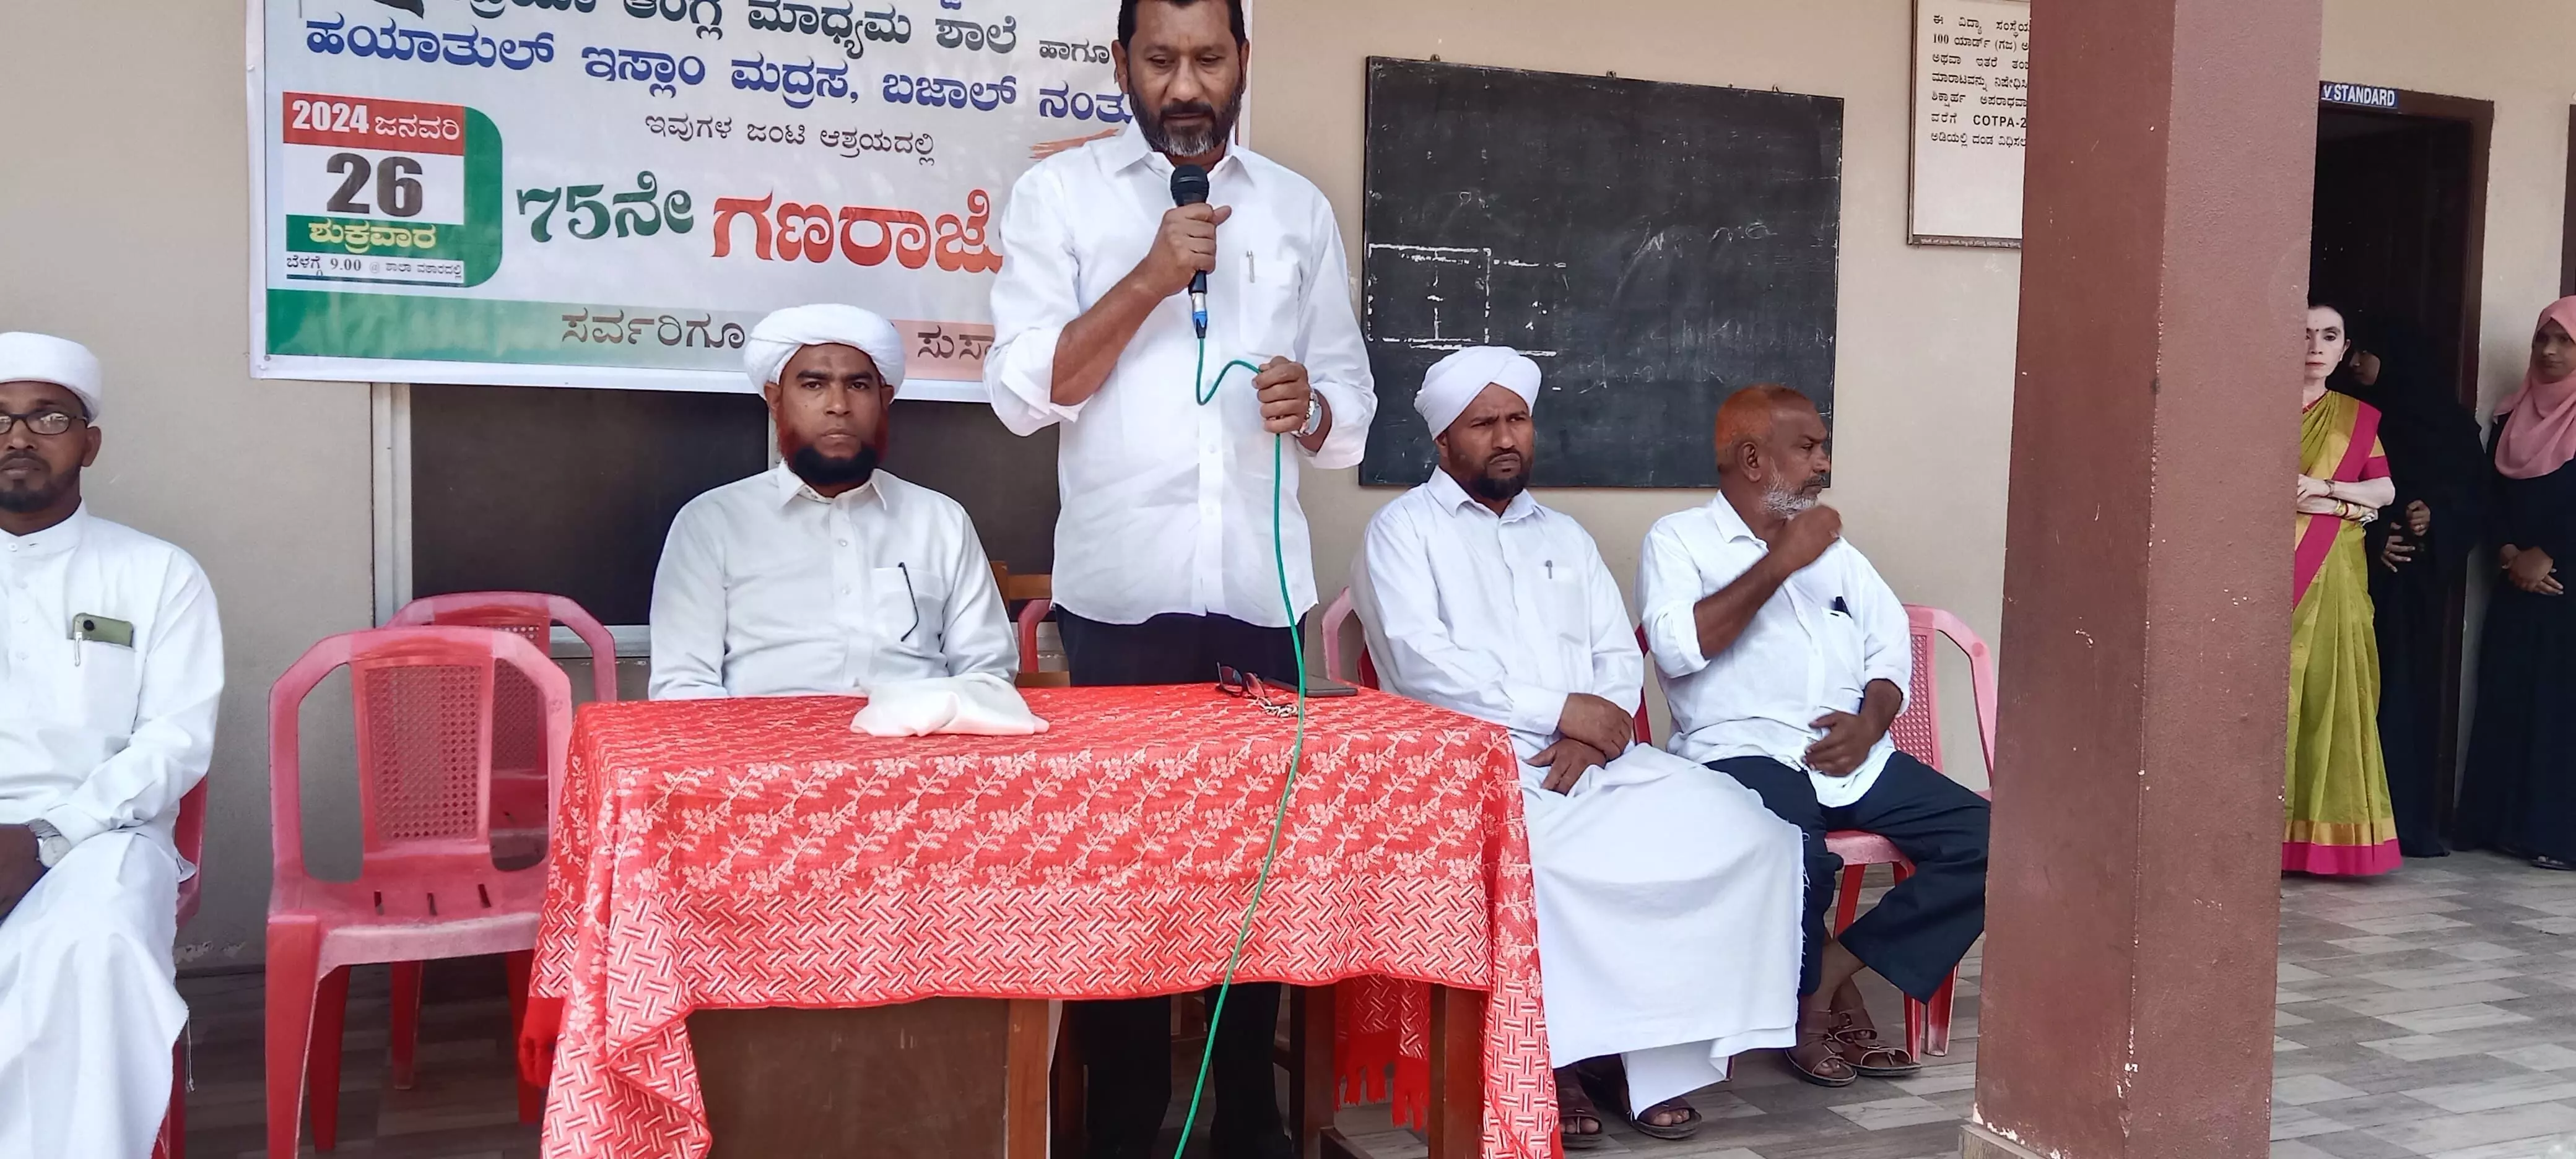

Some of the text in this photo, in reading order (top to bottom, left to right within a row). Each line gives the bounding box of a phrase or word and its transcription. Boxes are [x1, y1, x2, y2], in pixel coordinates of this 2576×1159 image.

[747, 0, 912, 60] ಮಾಧ್ಯಮ
[935, 14, 1017, 54] ಶಾಲೆ
[1039, 38, 1110, 64] ಹಾಗೂ
[1958, 16, 1982, 35] ವಿದ್ಯಾ
[1933, 33, 1949, 45] 100
[1995, 38, 2017, 53] (ಗಜ)
[307, 11, 554, 71] ಹಯಾತುಲ್
[581, 46, 706, 98] ಇಸ್ಲಾಂ
[731, 50, 859, 109] ಮದ್ರಸ,
[882, 73, 1017, 112] ಬಜಾಲ್
[1932, 53, 1962, 65] ಅಥವಾ
[1975, 56, 1998, 68] ಇತರೆ
[1931, 72, 1988, 92] ಮಾರಾಟವನ್ನು
[1931, 90, 1967, 108] ಶಿಕ್ಷಾರ್ಹ
[2333, 84, 2395, 106] STANDARD
[292, 99, 460, 141] 2024 ಜನವರಿ
[1931, 111, 1957, 124] ವರೆಗೆ
[645, 113, 935, 166] ಇವುಗಳ ಜಂಟಿ ಆಶ್ರಯದಲ್ಲಿ
[1931, 131, 1968, 149] ಅಡಿಯಲ್ಲಿ
[1972, 134, 1994, 145] ದಂಡ
[326, 152, 423, 217] 26
[516, 170, 695, 243] 75ನೇ
[308, 218, 437, 254] ಶುಕ್ರವಾರ
[286, 254, 323, 277] ಬೆಳಗ್ಗೆ
[330, 258, 362, 271] 9.00
[562, 307, 745, 349] ಸರ್ವರಿಗೂ
